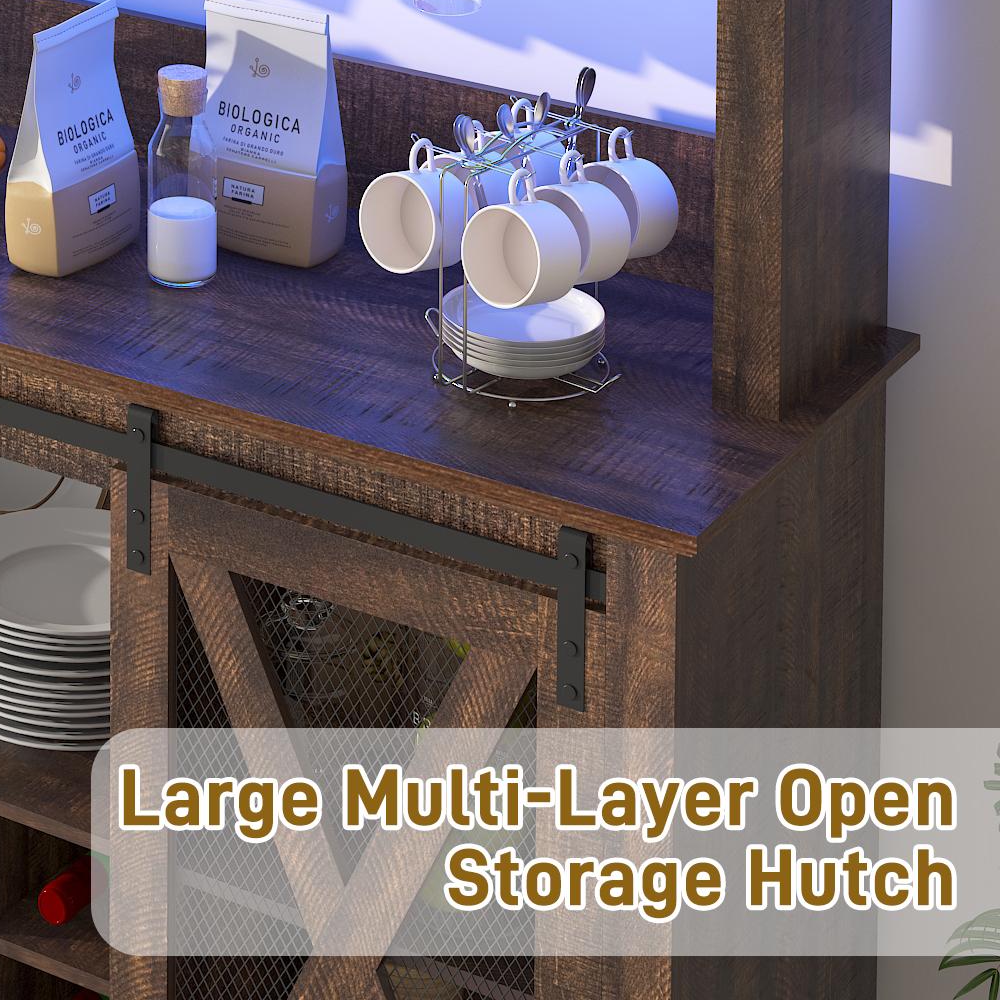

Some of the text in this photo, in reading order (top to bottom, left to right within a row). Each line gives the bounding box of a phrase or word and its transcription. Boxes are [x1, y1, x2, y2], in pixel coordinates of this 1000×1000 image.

[57, 108, 114, 146] BIOLOGICA
[218, 101, 301, 134] BIOLOGICA
[73, 131, 107, 154] ORGANIC
[230, 123, 281, 144] ORGANIC
[231, 184, 255, 193] NATURA
[231, 189, 254, 198] FARINA
